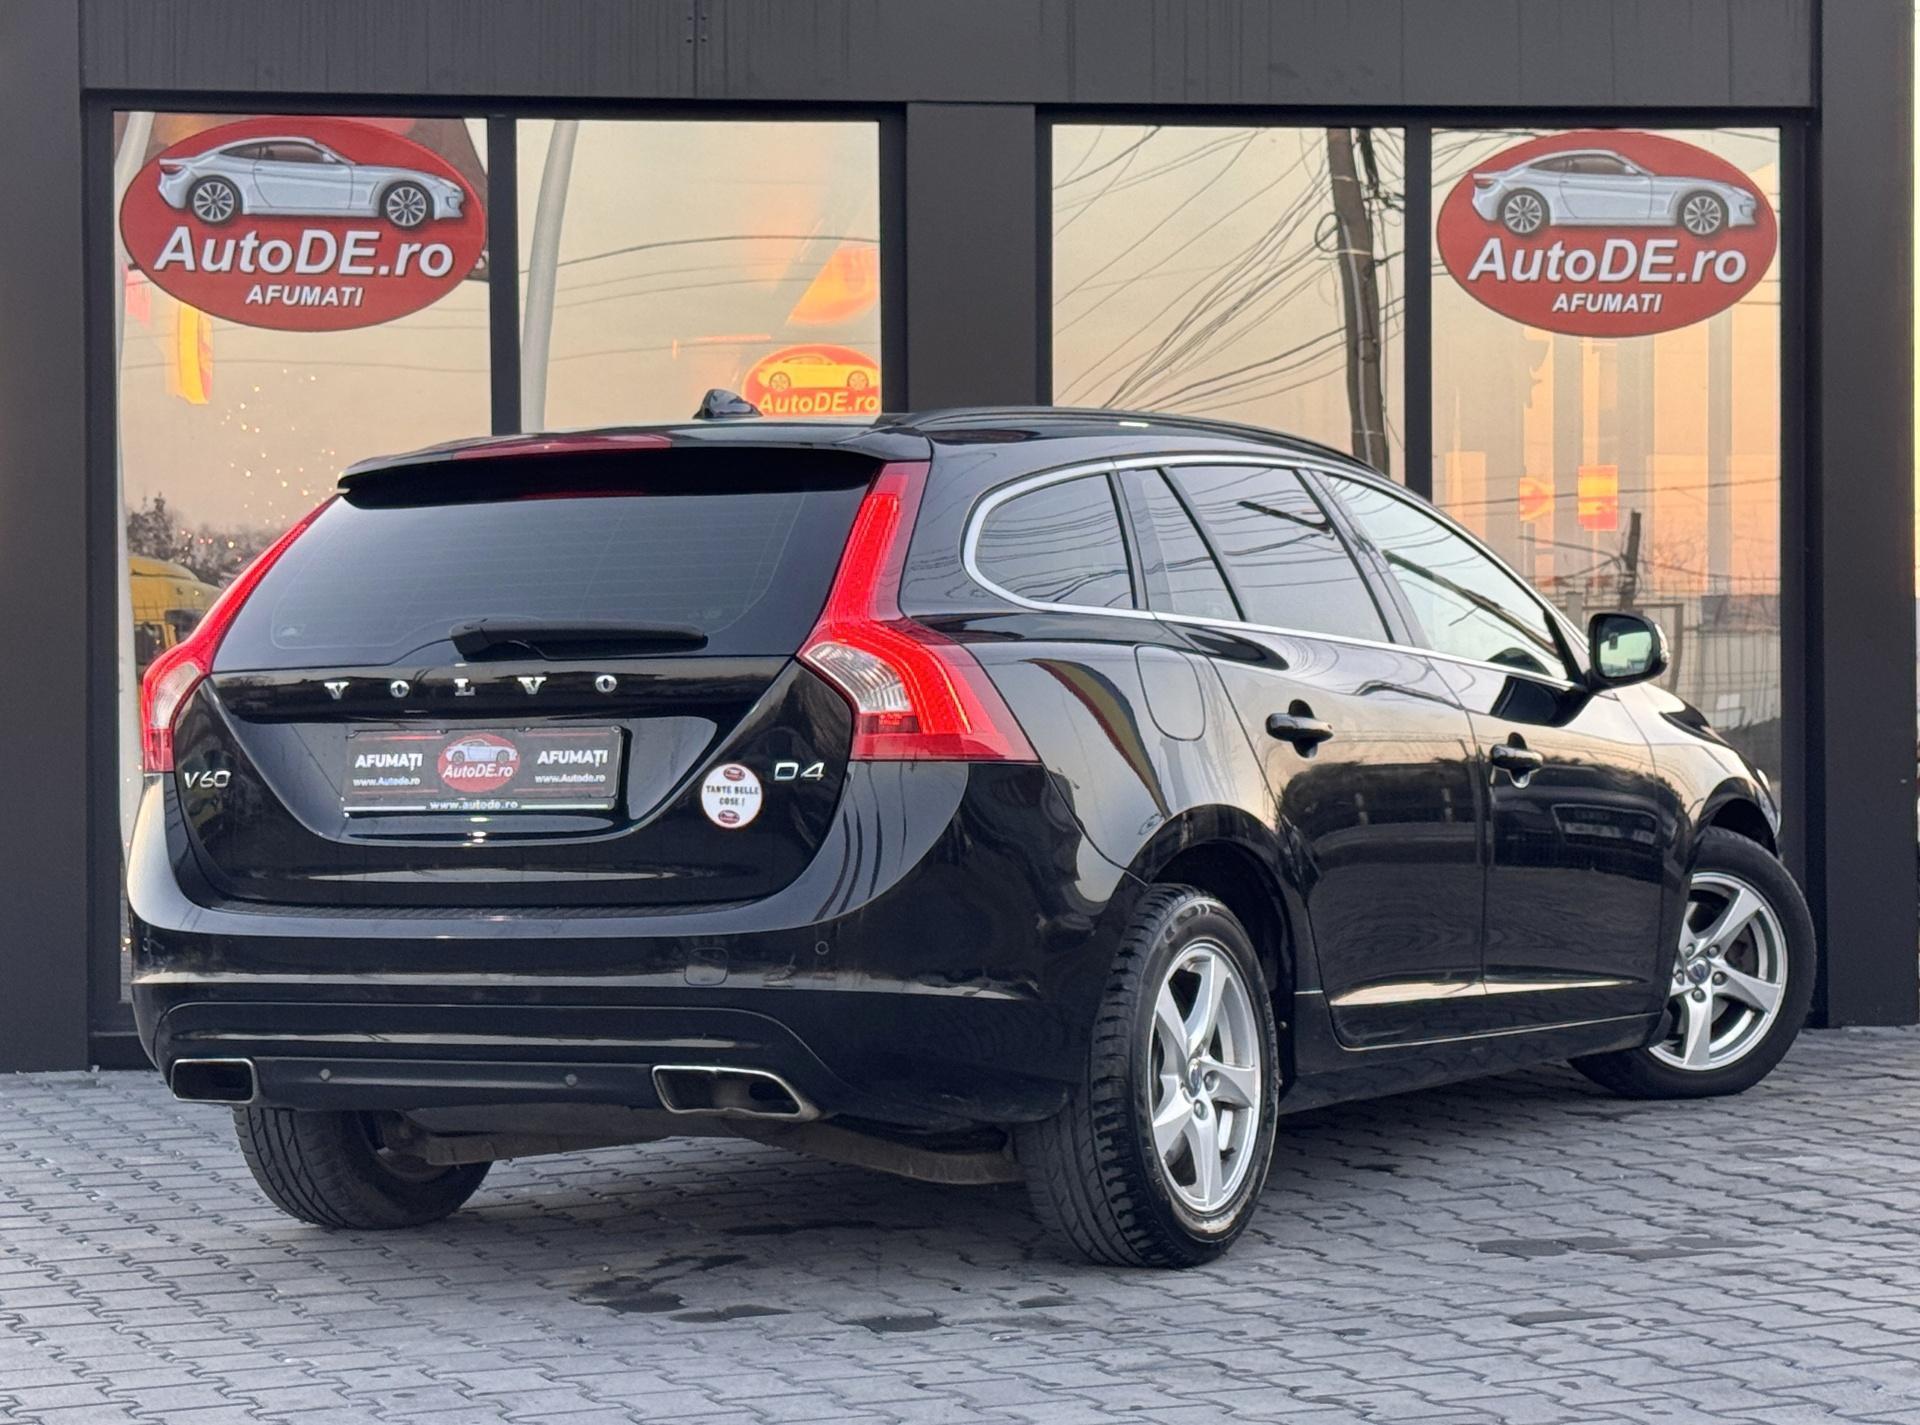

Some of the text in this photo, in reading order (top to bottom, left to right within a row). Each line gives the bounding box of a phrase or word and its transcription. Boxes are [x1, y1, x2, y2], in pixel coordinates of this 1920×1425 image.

[154, 226, 455, 278] AutoDE.ro
[1468, 238, 1748, 284] AutoDE.ro
[246, 285, 365, 307] AFUMATI
[1552, 293, 1663, 313] AFUMATI
[759, 392, 879, 413] AutoDE.ro
[324, 675, 618, 700] VOLVO
[184, 770, 231, 789] V60
[442, 764, 514, 779] AutoDE.ro
[774, 762, 825, 781] D4
[734, 785, 759, 795] BELLE
[430, 800, 519, 811] www.autode.ro
